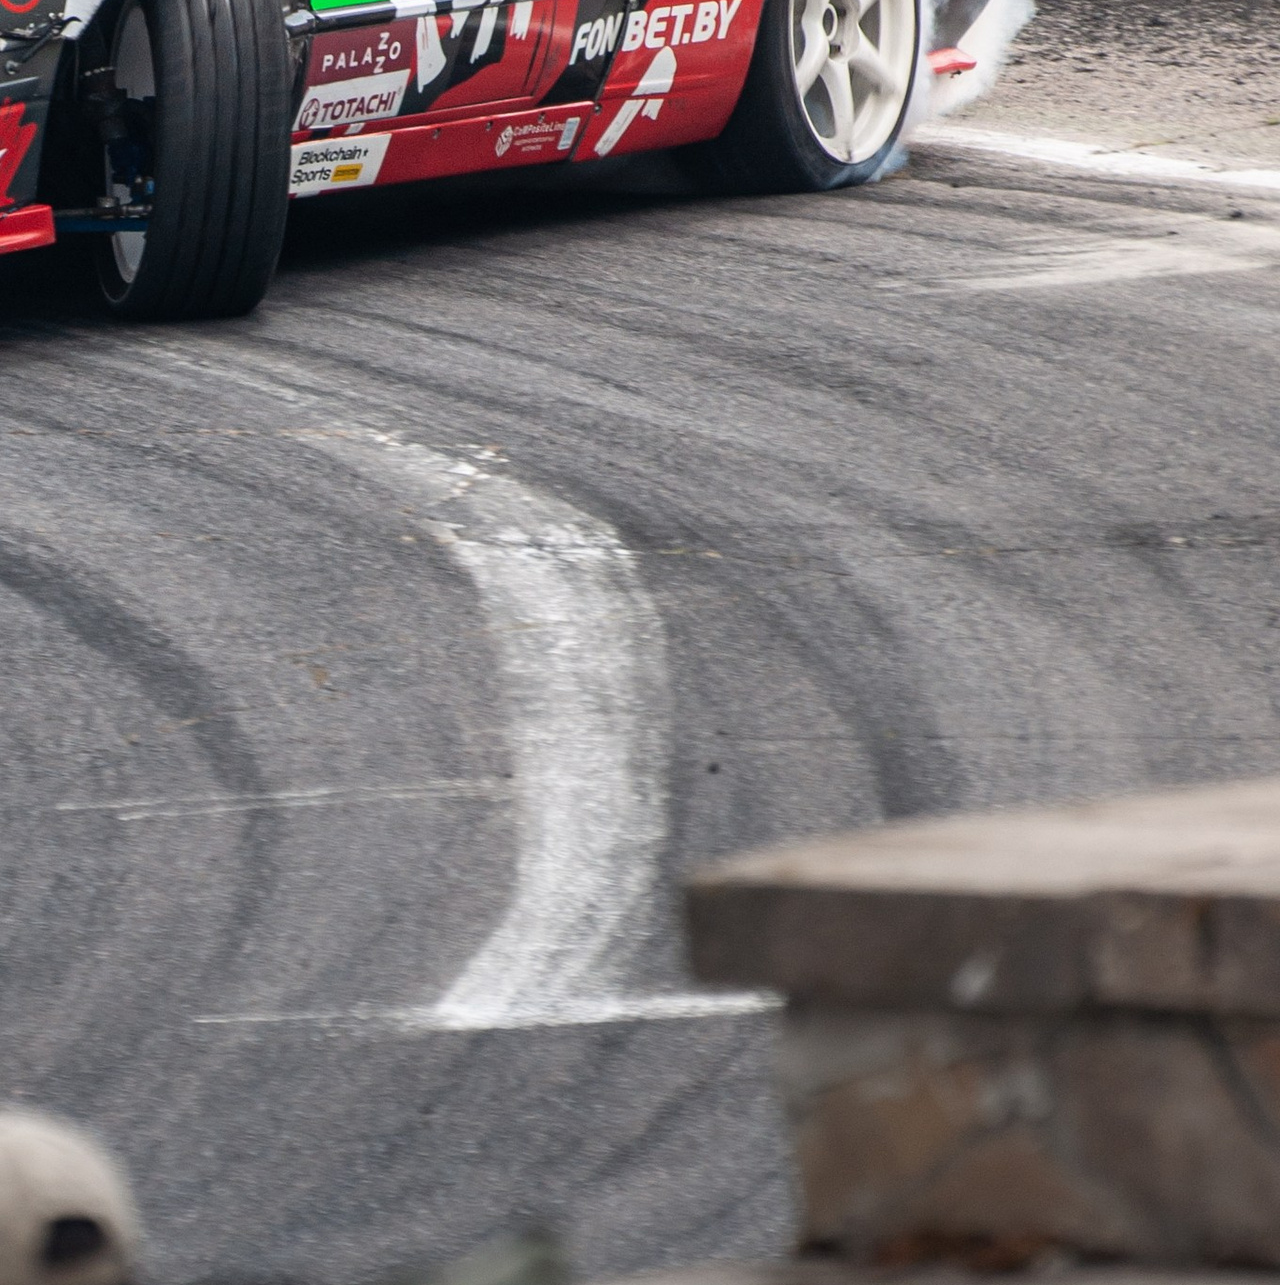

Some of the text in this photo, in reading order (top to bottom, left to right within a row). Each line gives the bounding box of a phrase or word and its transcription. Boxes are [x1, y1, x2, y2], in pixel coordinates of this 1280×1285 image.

[321, 91, 396, 123] TOTACHI
[298, 145, 361, 165] Blockchain
[291, 166, 332, 186] Sports
